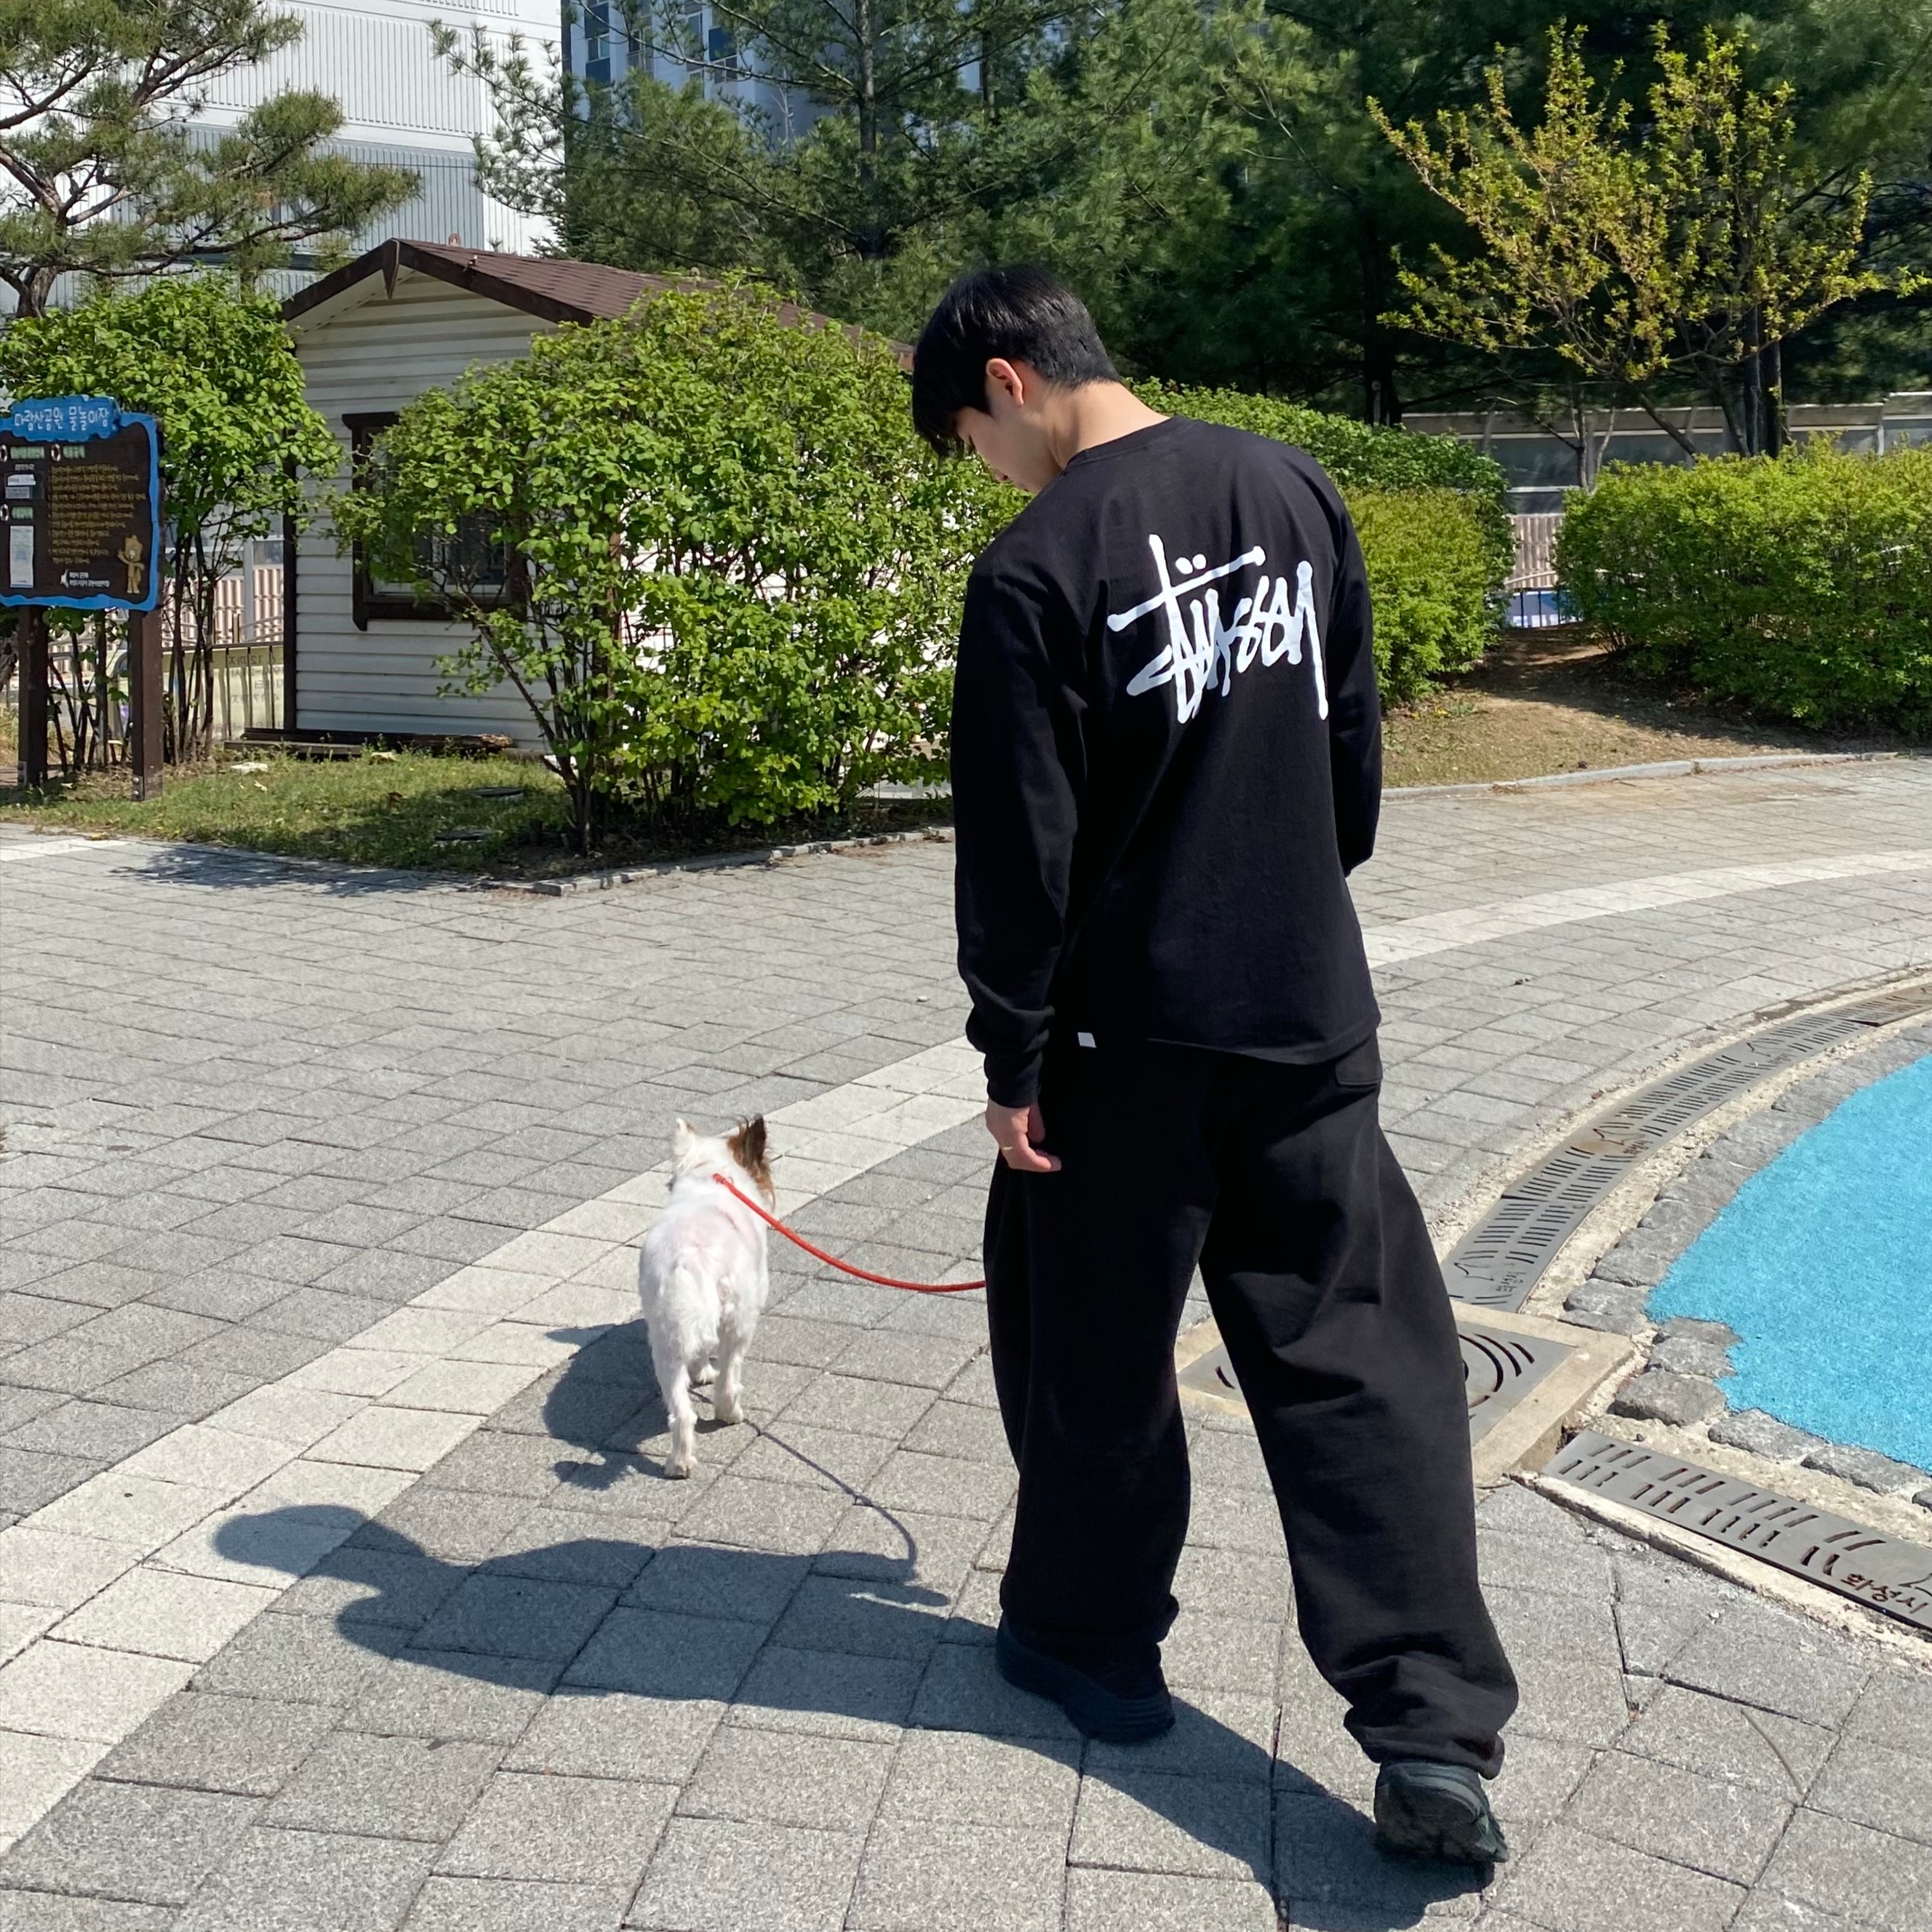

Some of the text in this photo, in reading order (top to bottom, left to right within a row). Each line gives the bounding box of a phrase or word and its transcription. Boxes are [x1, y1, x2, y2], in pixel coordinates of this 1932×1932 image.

[15, 406, 109, 431] 다람산공원 물놀이장
[1840, 1573, 1929, 1614] 화성시
